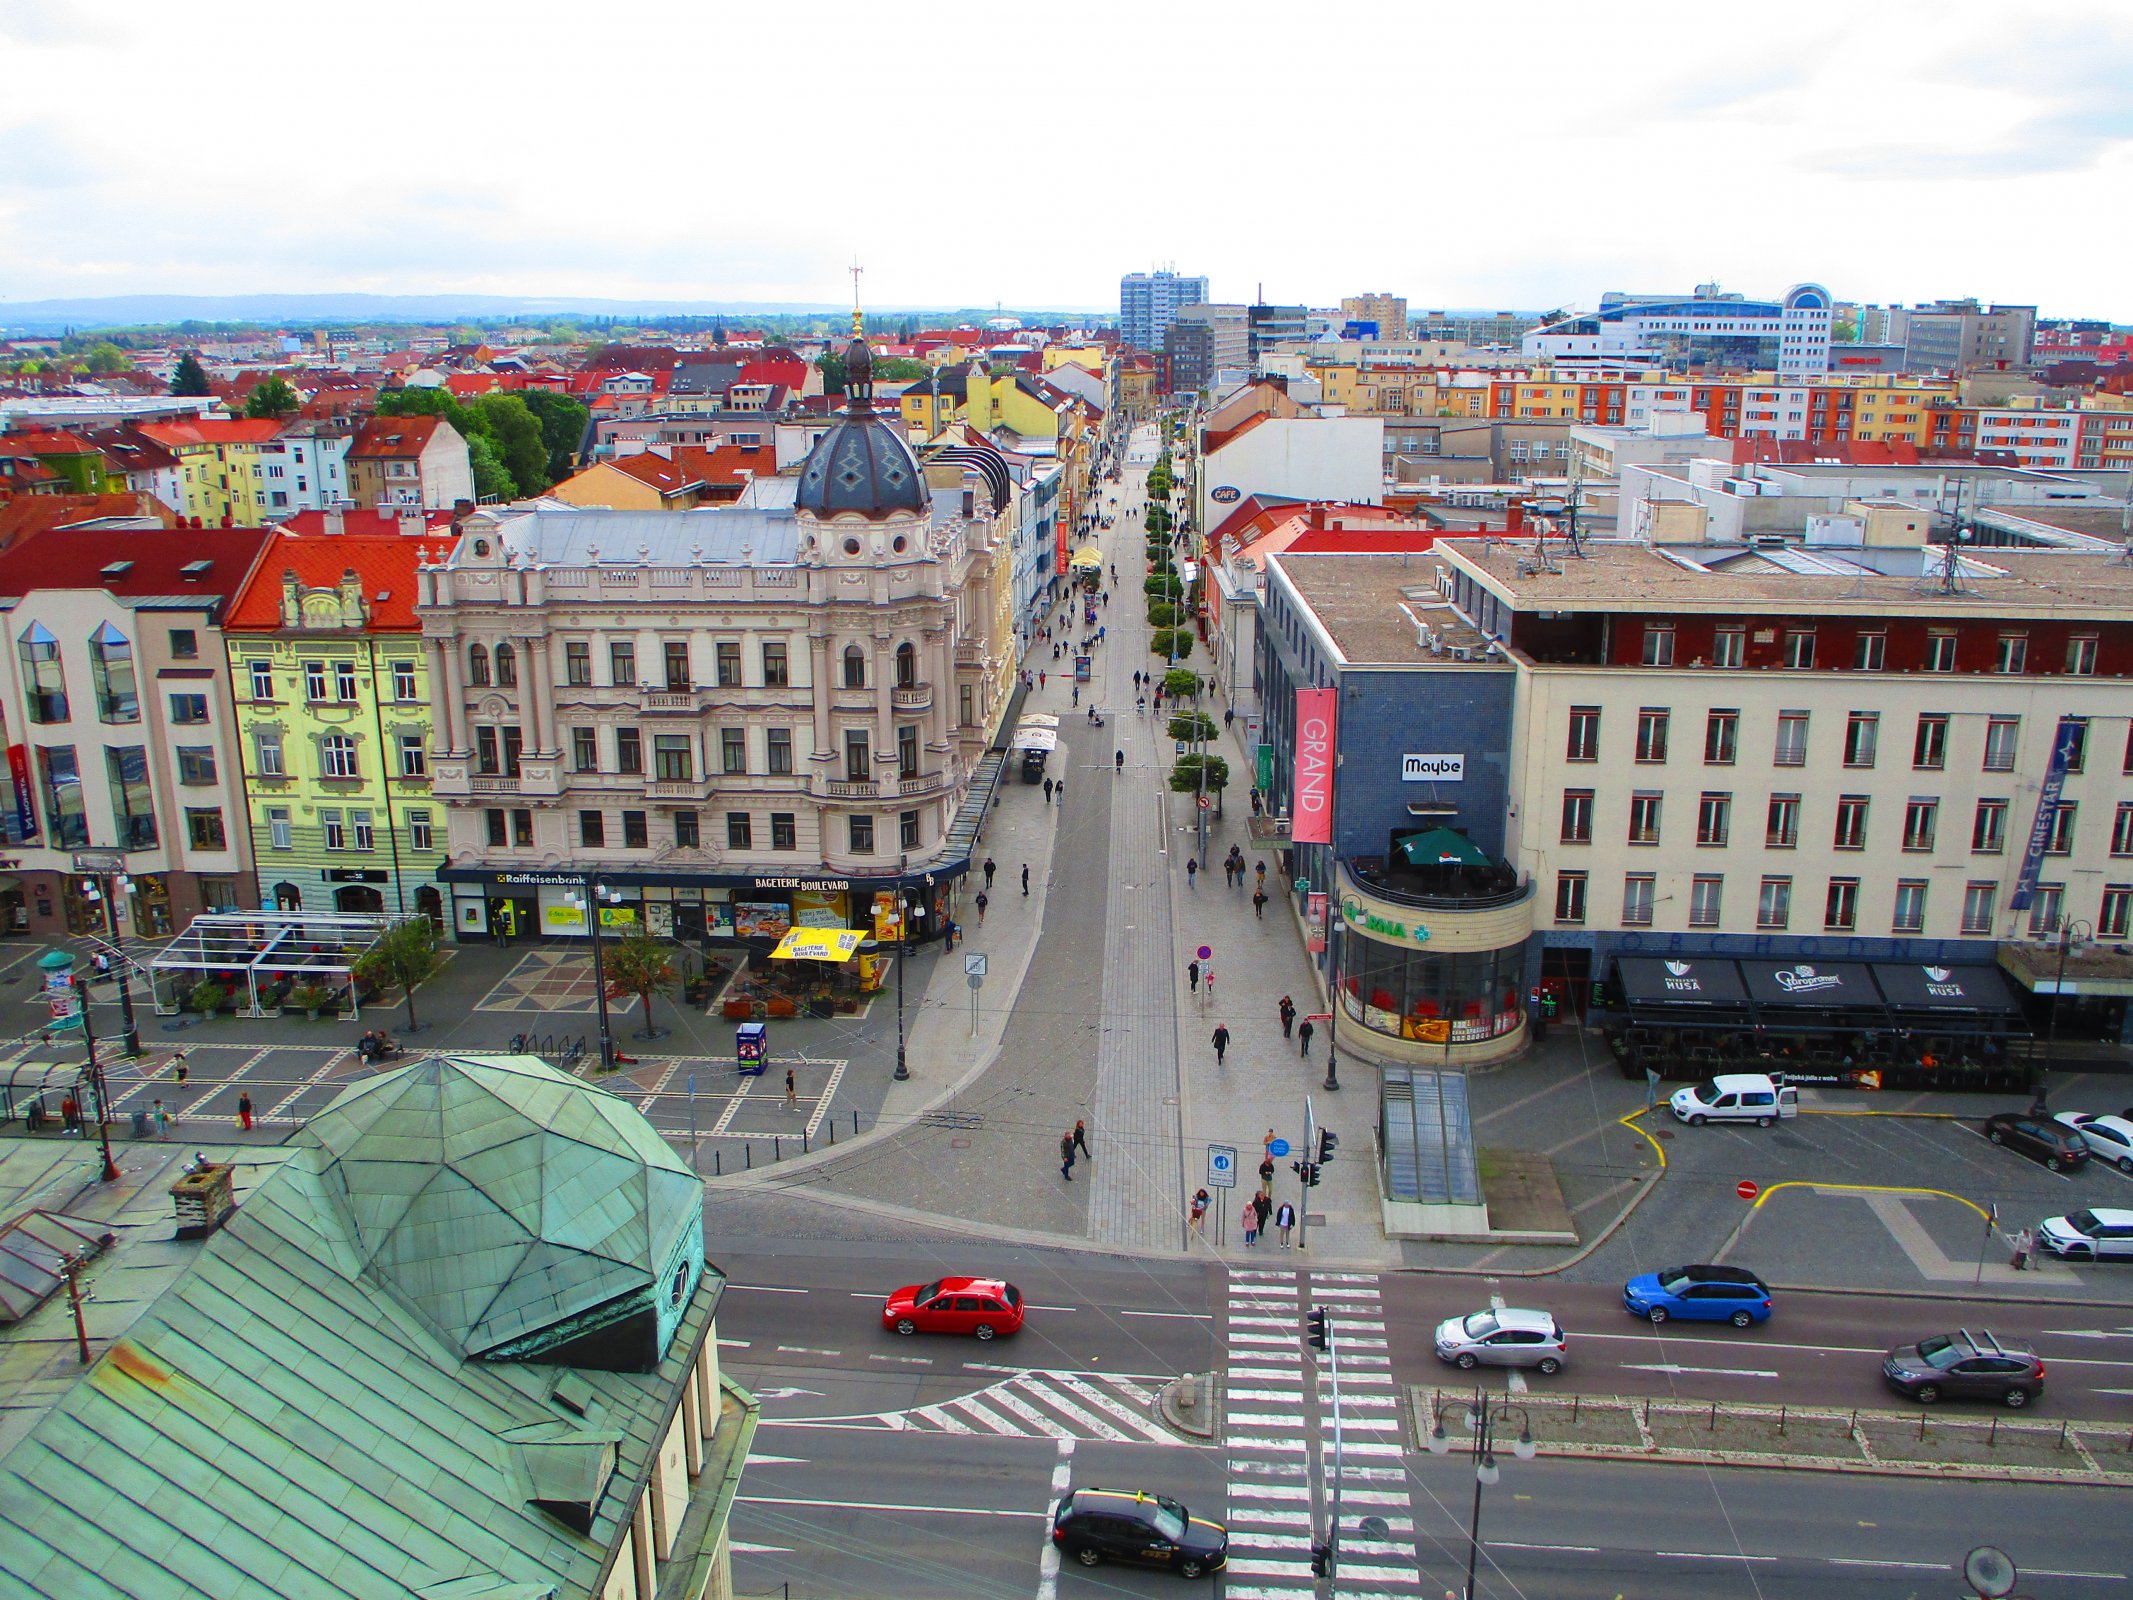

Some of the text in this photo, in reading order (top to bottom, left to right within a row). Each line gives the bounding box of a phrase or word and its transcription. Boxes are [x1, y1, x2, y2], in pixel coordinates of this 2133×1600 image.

[1301, 718, 1328, 812] GRAND
[1405, 759, 1460, 775] Maybe
[2029, 781, 2060, 857] CINESTAR
[505, 874, 586, 885] Raiffeisenbank
[755, 878, 849, 891] BAGETERIE BOULEVARD
[1666, 981, 1702, 990] HUSA
[1775, 970, 1843, 991] Staropramen
[1929, 987, 1966, 996] HUSA
